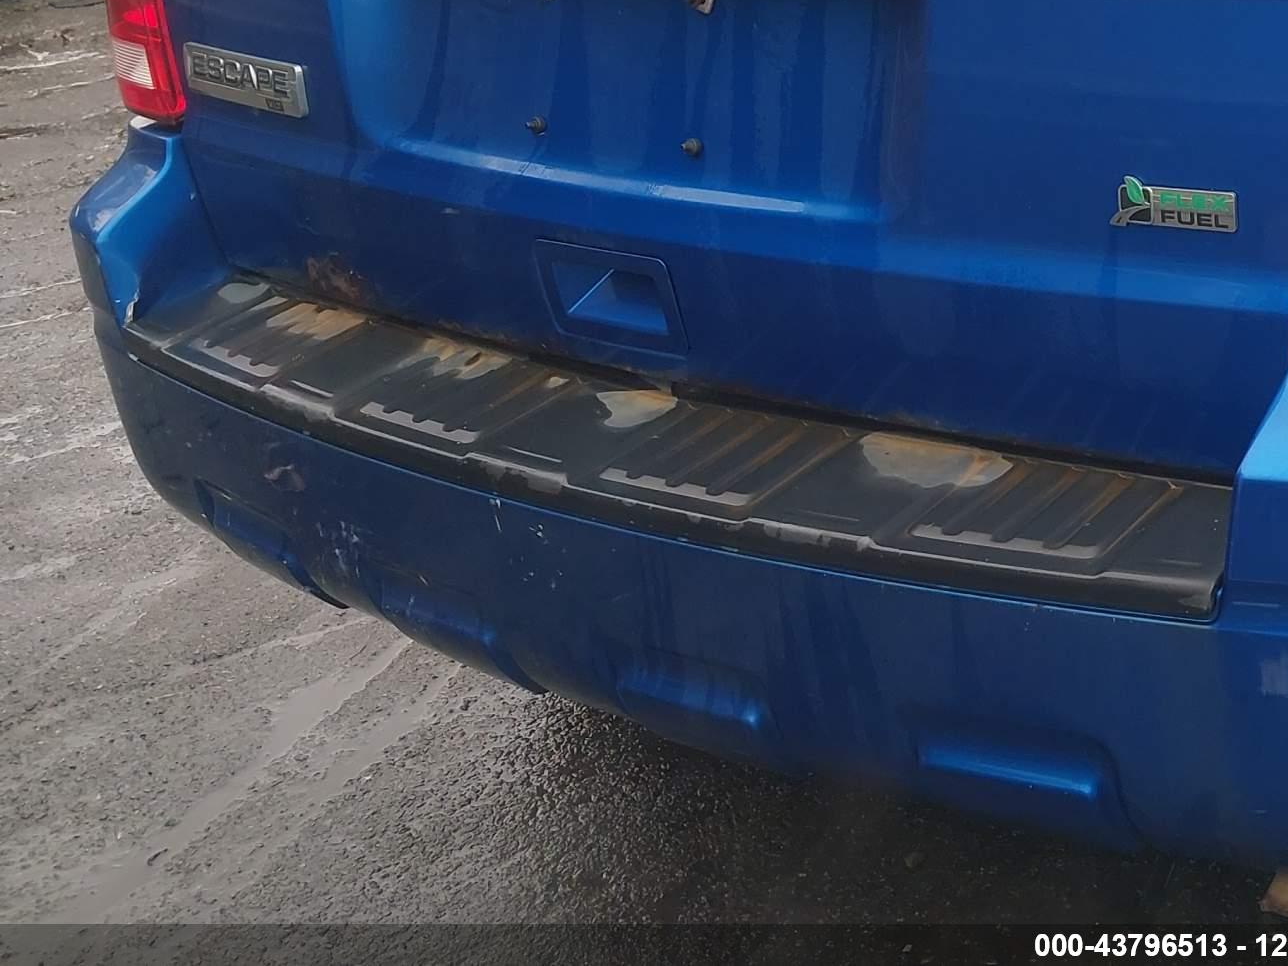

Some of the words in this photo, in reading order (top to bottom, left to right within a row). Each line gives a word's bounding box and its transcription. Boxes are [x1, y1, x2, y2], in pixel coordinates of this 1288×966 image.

[191, 51, 291, 99] ESCAPE
[1160, 192, 1230, 212] FLEX
[1160, 209, 1230, 229] FUEL
